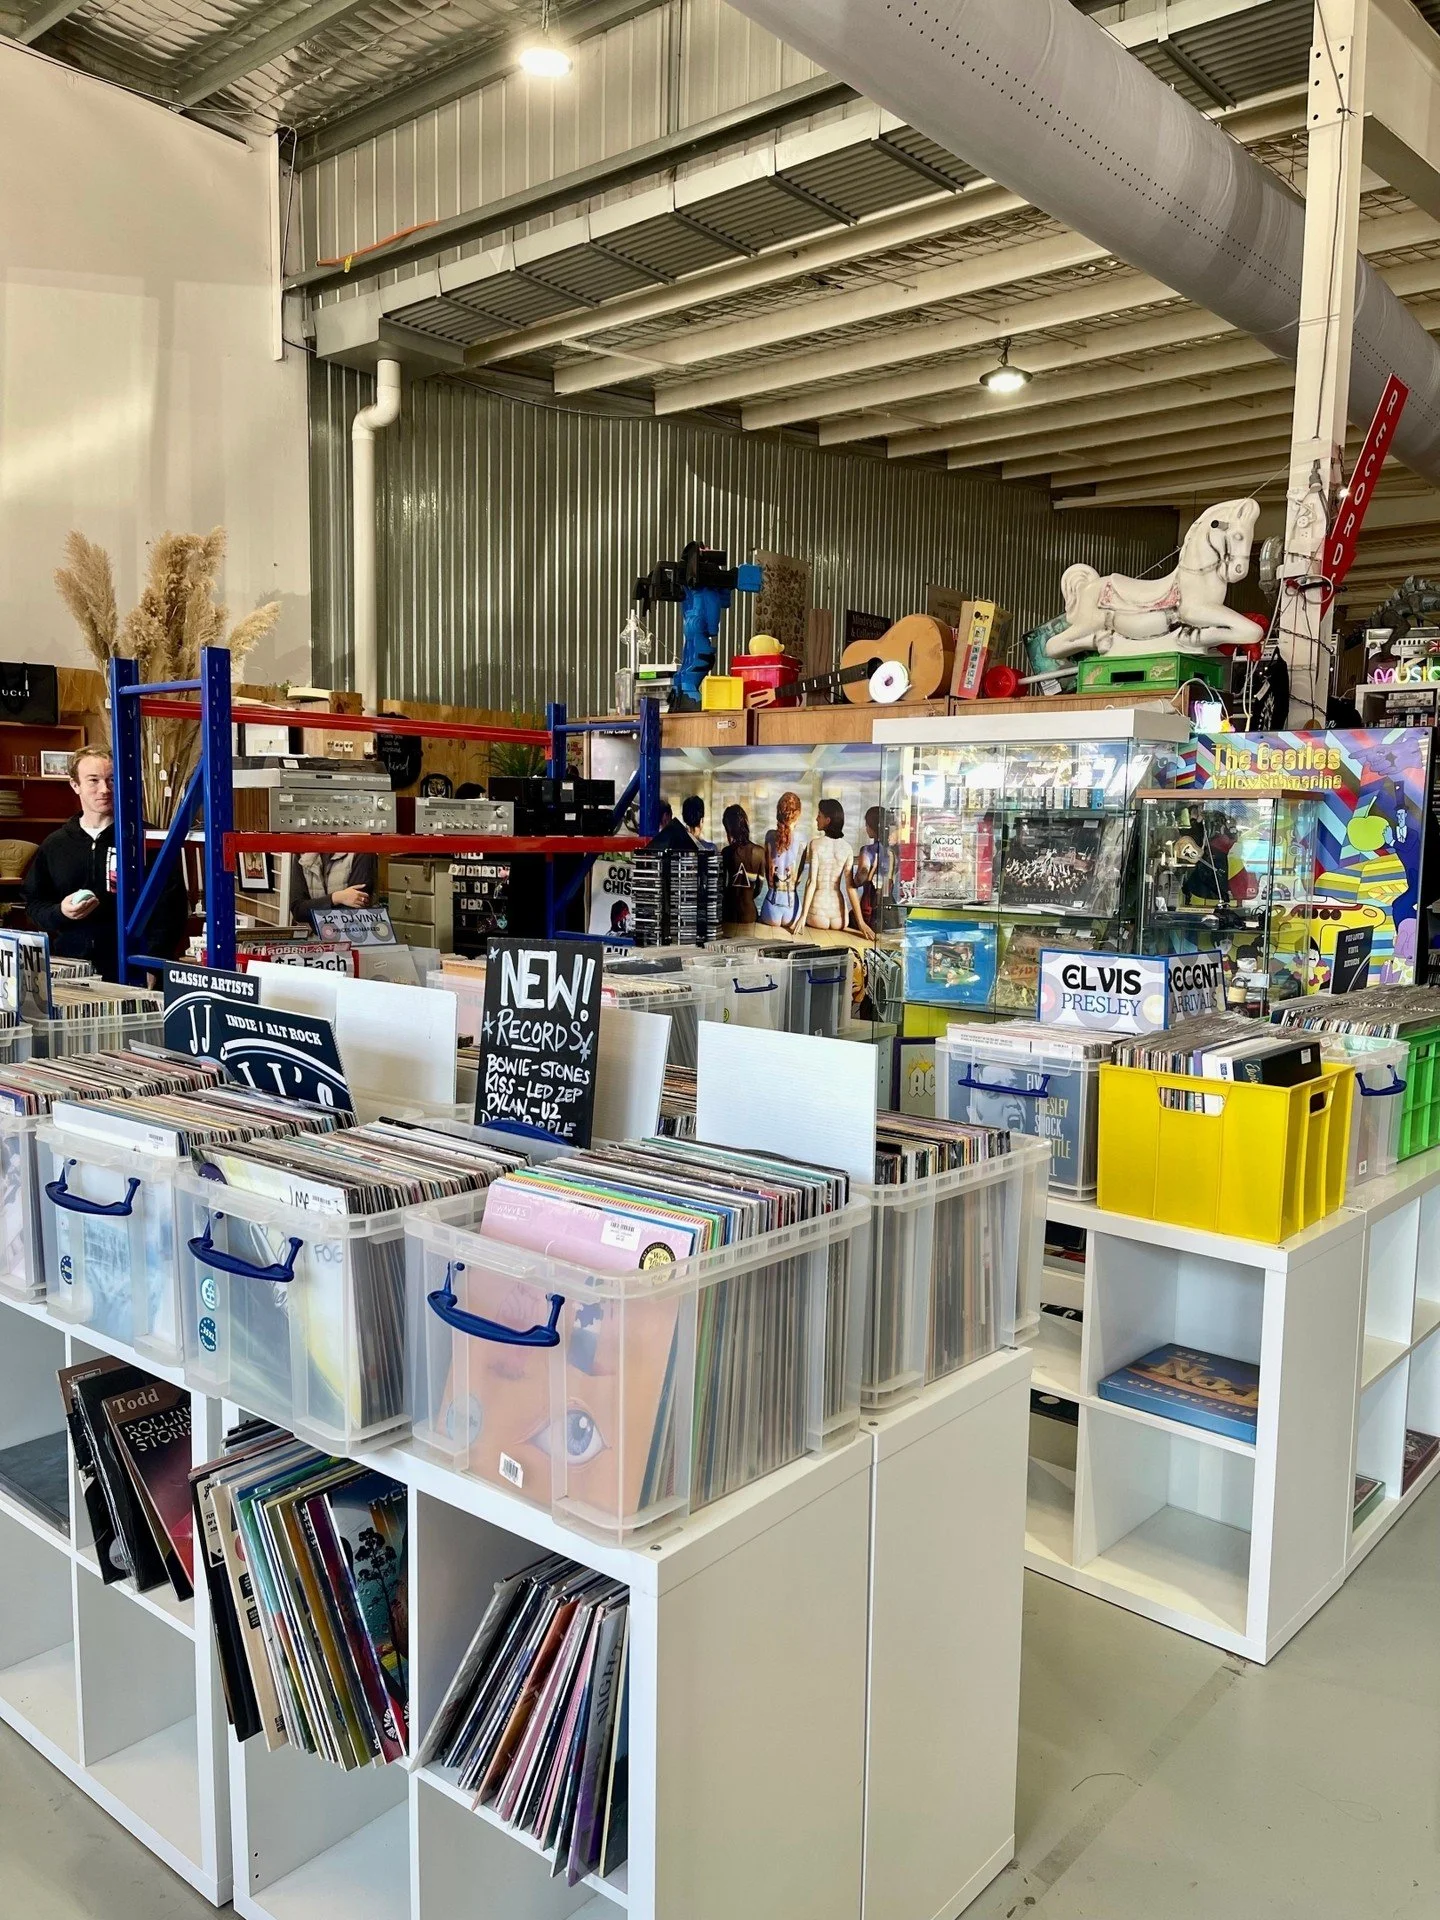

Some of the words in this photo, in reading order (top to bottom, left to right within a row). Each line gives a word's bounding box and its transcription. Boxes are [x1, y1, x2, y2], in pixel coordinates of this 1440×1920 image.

[1374, 665, 1440, 685] MUSIC
[1211, 743, 1252, 771] The
[1257, 741, 1341, 771] Beatles
[1212, 771, 1260, 789] Yellow
[1260, 770, 1342, 789] Submarine
[322, 915, 338, 924] 12"
[341, 914, 355, 924] DJ
[355, 914, 386, 923] VINYL
[304, 955, 347, 972] Each
[169, 969, 209, 989] CLASSIC
[210, 975, 254, 997] ARTISTS
[500, 949, 596, 1022] NEW!
[1062, 964, 1142, 996] ELVIS
[1061, 993, 1142, 1018] PRESLEY
[226, 1014, 257, 1032] INDIE
[266, 1022, 288, 1039] ALT
[287, 1028, 323, 1047] ROCK
[496, 1009, 583, 1052] RECORDS
[485, 1072, 516, 1094] KISS
[487, 1093, 528, 1117] DYLAN
[541, 1101, 562, 1120] U2
[314, 1244, 343, 1263] FOG
[112, 1388, 160, 1414] Todd
[596, 1638, 622, 1726] NIGHT
